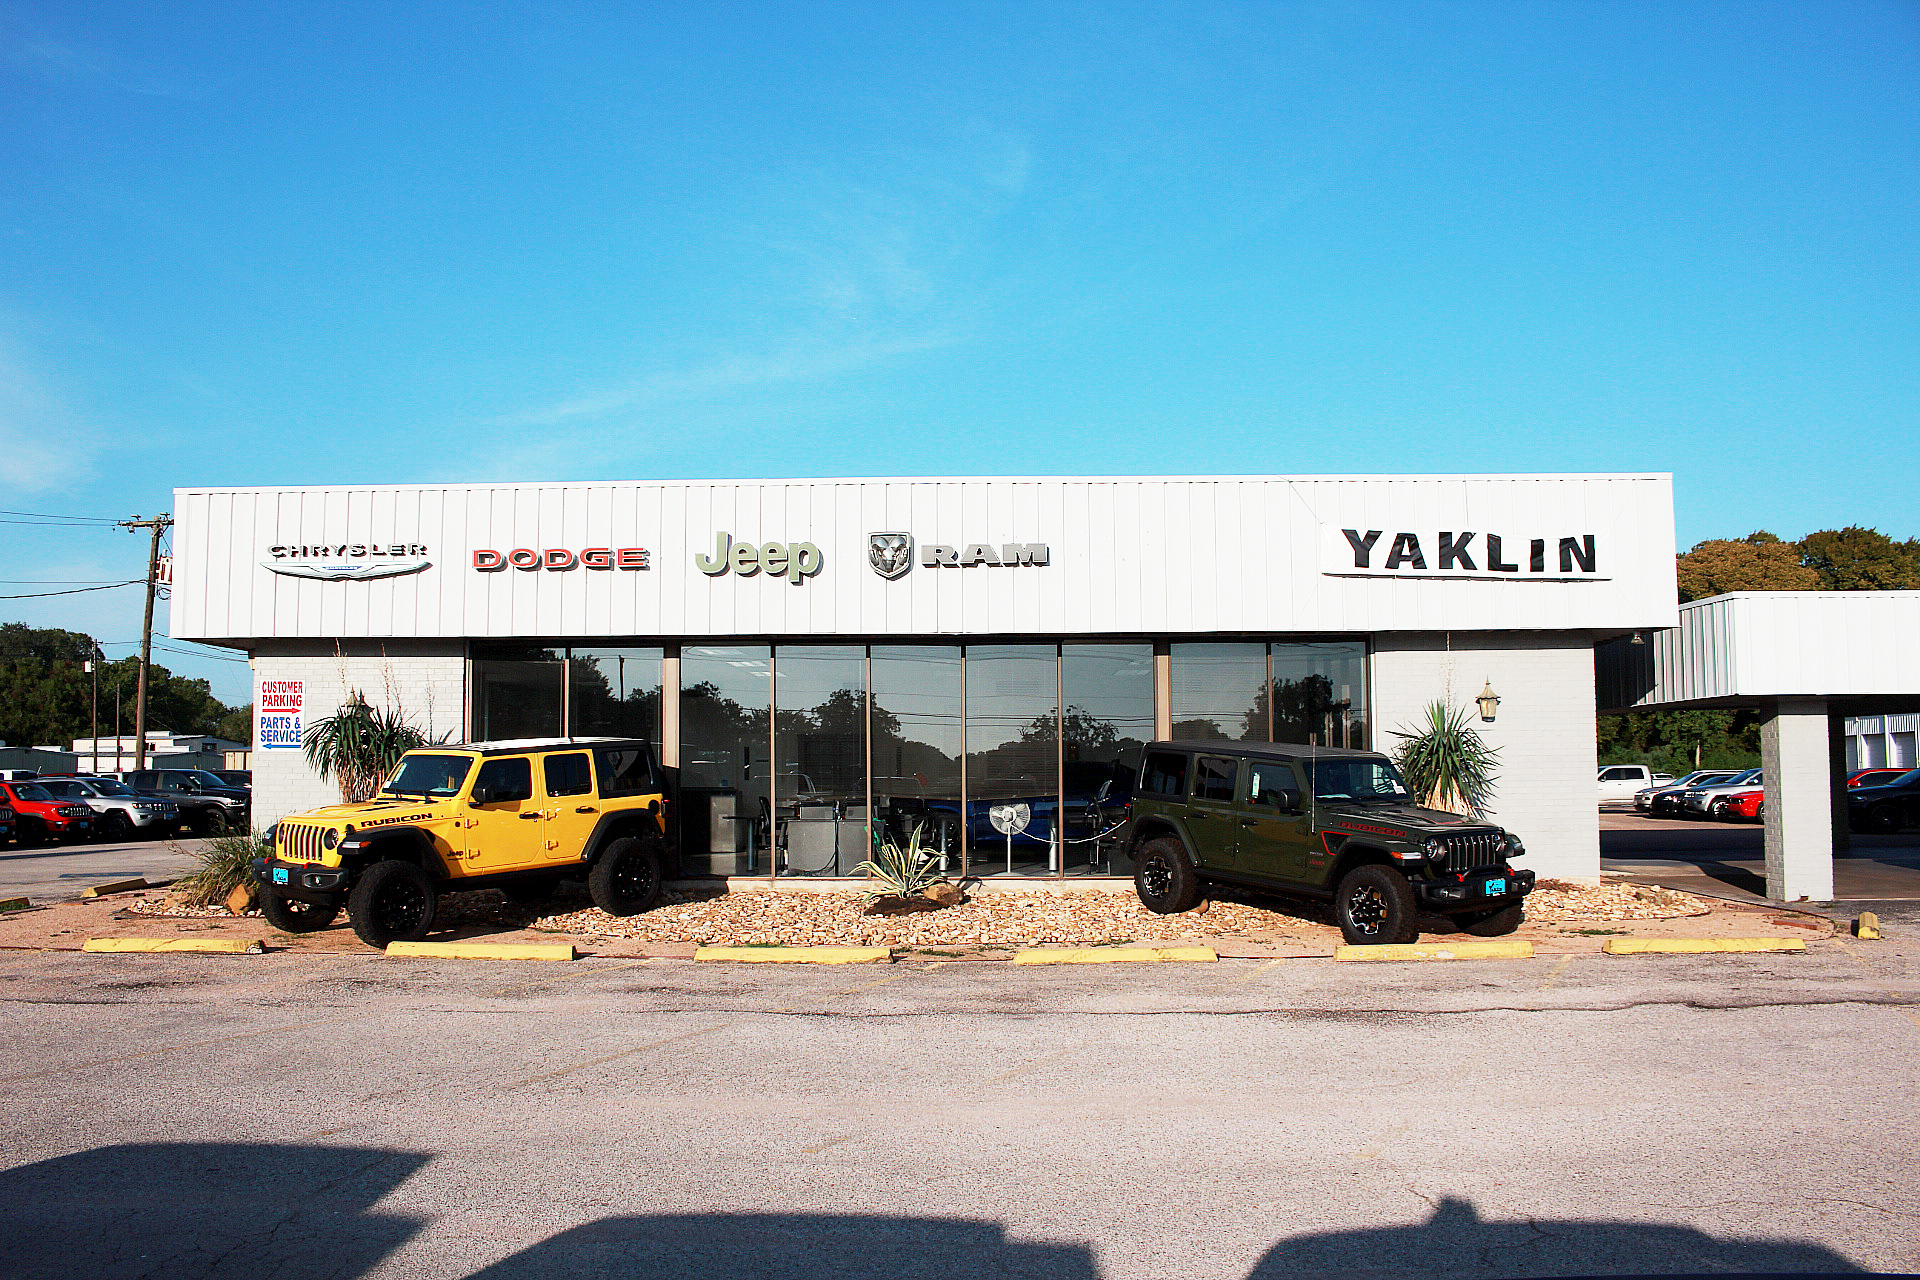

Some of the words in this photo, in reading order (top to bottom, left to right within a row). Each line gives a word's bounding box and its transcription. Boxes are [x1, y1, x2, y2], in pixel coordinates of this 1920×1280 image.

[269, 544, 428, 558] CHRYSLER
[695, 531, 823, 585] Jeep
[921, 543, 1049, 567] RAM
[1341, 529, 1596, 573] YAKLIN
[472, 547, 649, 571] DODGE
[262, 681, 303, 693] CUSTOMER
[262, 695, 302, 706] PARKING
[261, 717, 291, 729] PARTS
[294, 717, 301, 729] &
[260, 730, 301, 742] SERVICE
[360, 813, 433, 827] RUBICON
[1338, 821, 1408, 837] RUBICON
